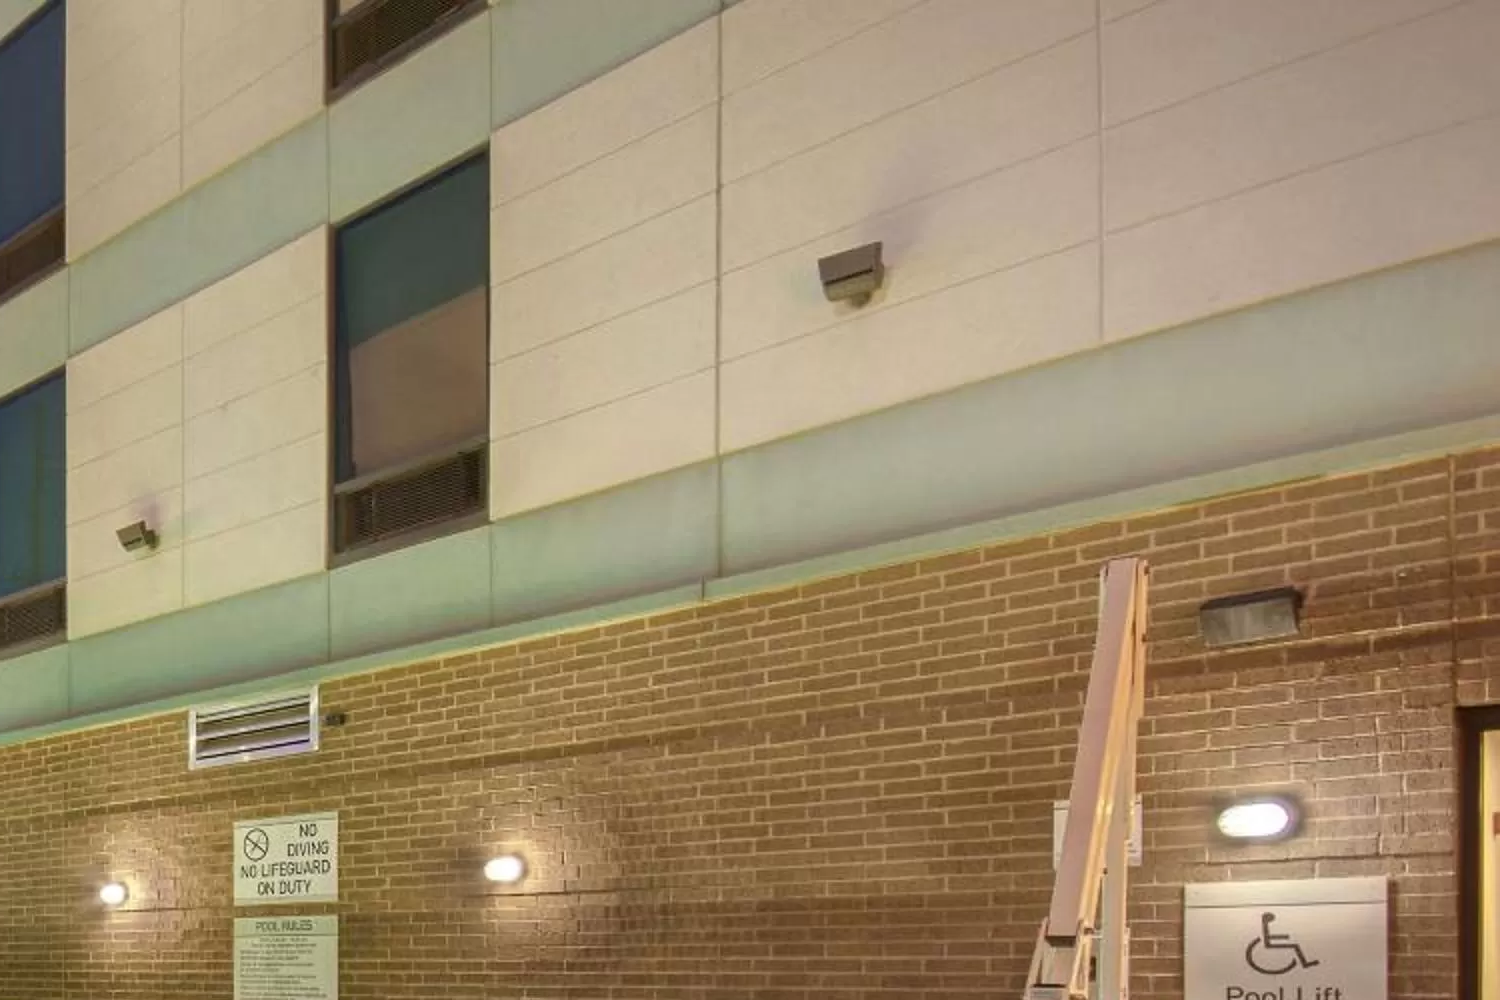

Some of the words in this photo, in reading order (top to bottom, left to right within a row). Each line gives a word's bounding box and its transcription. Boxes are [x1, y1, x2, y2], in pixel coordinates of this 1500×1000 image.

[299, 823, 318, 837] NO
[287, 841, 329, 857] DIVING
[240, 864, 257, 879] NO
[261, 859, 331, 878] LIFEGUARD
[257, 881, 275, 896] ON
[279, 879, 312, 895] DUTY
